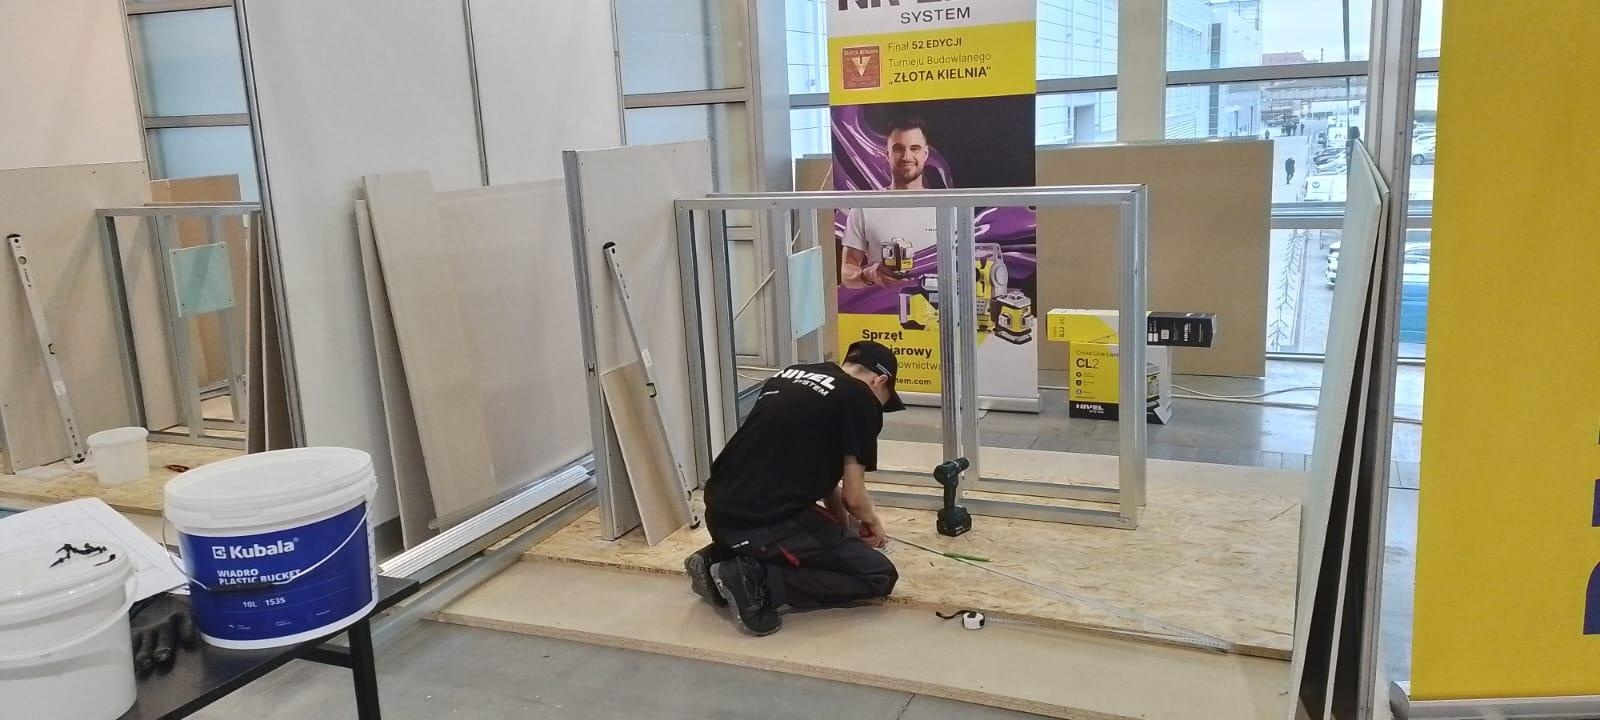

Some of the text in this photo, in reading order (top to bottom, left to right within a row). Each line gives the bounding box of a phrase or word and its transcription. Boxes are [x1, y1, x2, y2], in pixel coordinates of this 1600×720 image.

[900, 6, 970, 24] SYSTEM
[912, 40, 924, 50] 52
[926, 37, 962, 49] EDYCJI
[888, 52, 992, 67] Turnieju Budowlanego
[862, 328, 904, 342] Sprzęt
[1076, 358, 1099, 369] CL2
[773, 368, 836, 390] NIVEL
[217, 568, 259, 578] WIADRO
[260, 569, 301, 582] BUCKET
[218, 577, 258, 586] PLASTIC
[264, 597, 286, 606] 1535
